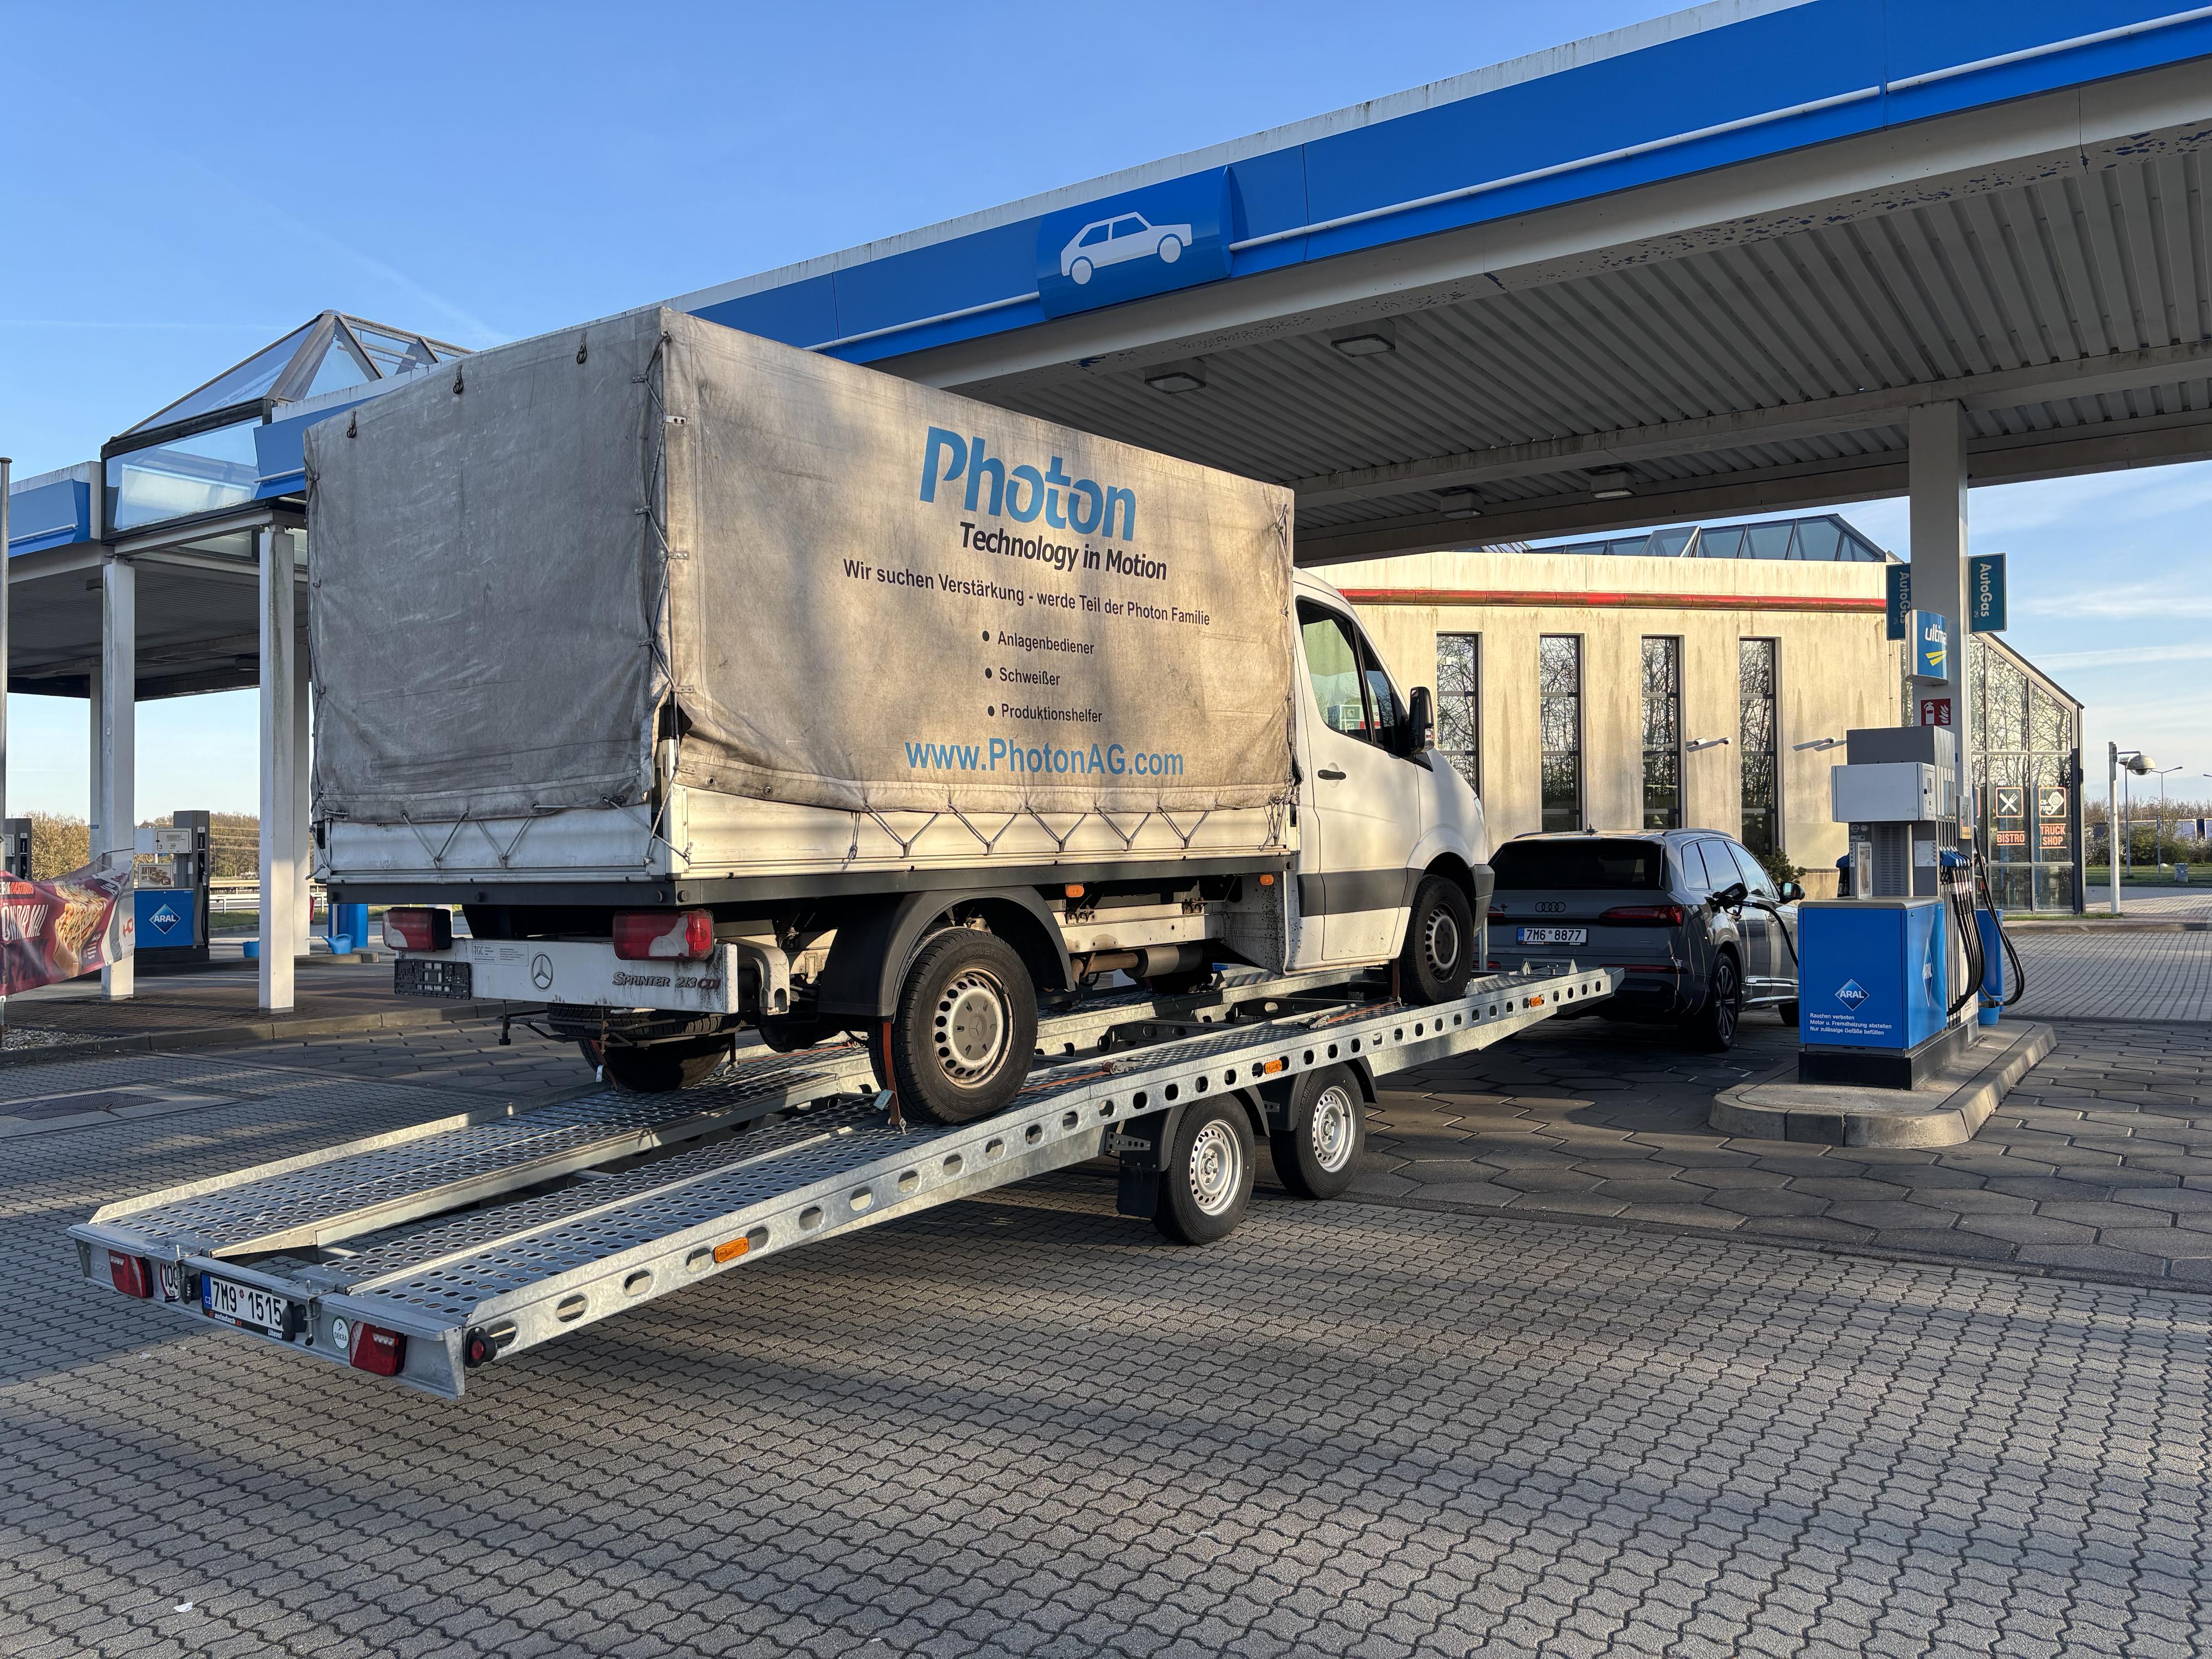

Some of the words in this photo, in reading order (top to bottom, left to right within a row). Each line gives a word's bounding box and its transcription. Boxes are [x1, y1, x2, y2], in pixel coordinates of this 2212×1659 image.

[920, 425, 1136, 542] Photon
[960, 521, 1079, 572] Technology
[1083, 544, 1100, 570] in
[1105, 549, 1167, 581] Motion
[843, 559, 872, 580] Wir
[877, 568, 934, 589] suchen
[938, 573, 1024, 607] Verstärkung
[1037, 592, 1076, 609] werde
[1079, 594, 1100, 613] Teil
[1104, 598, 1124, 615] der
[1128, 601, 1168, 620] Photon
[1172, 607, 1210, 625] Familie
[1980, 562, 1993, 618] AutoGas
[998, 630, 1094, 654] Anlagenbediener
[999, 667, 1060, 686] Schweißer
[1001, 703, 1103, 722] Produktionshelfer
[905, 737, 1183, 775] www.PhotonAG.com
[1997, 833, 2025, 843] BISTRO
[2040, 826, 2065, 835] TRUCK
[2043, 836, 2063, 846] SHOP
[1526, 930, 1546, 940] 7M6
[1554, 930, 1582, 941] 8877
[675, 977, 697, 988] 213
[1839, 990, 1865, 999] ARAL
[1832, 1020, 1867, 1029] Fremdheizung
[205, 1296, 211, 1305] CZ
[212, 1281, 237, 1313] 7M9
[248, 1291, 283, 1327] 1515
[334, 1331, 348, 1341] DEKRA
